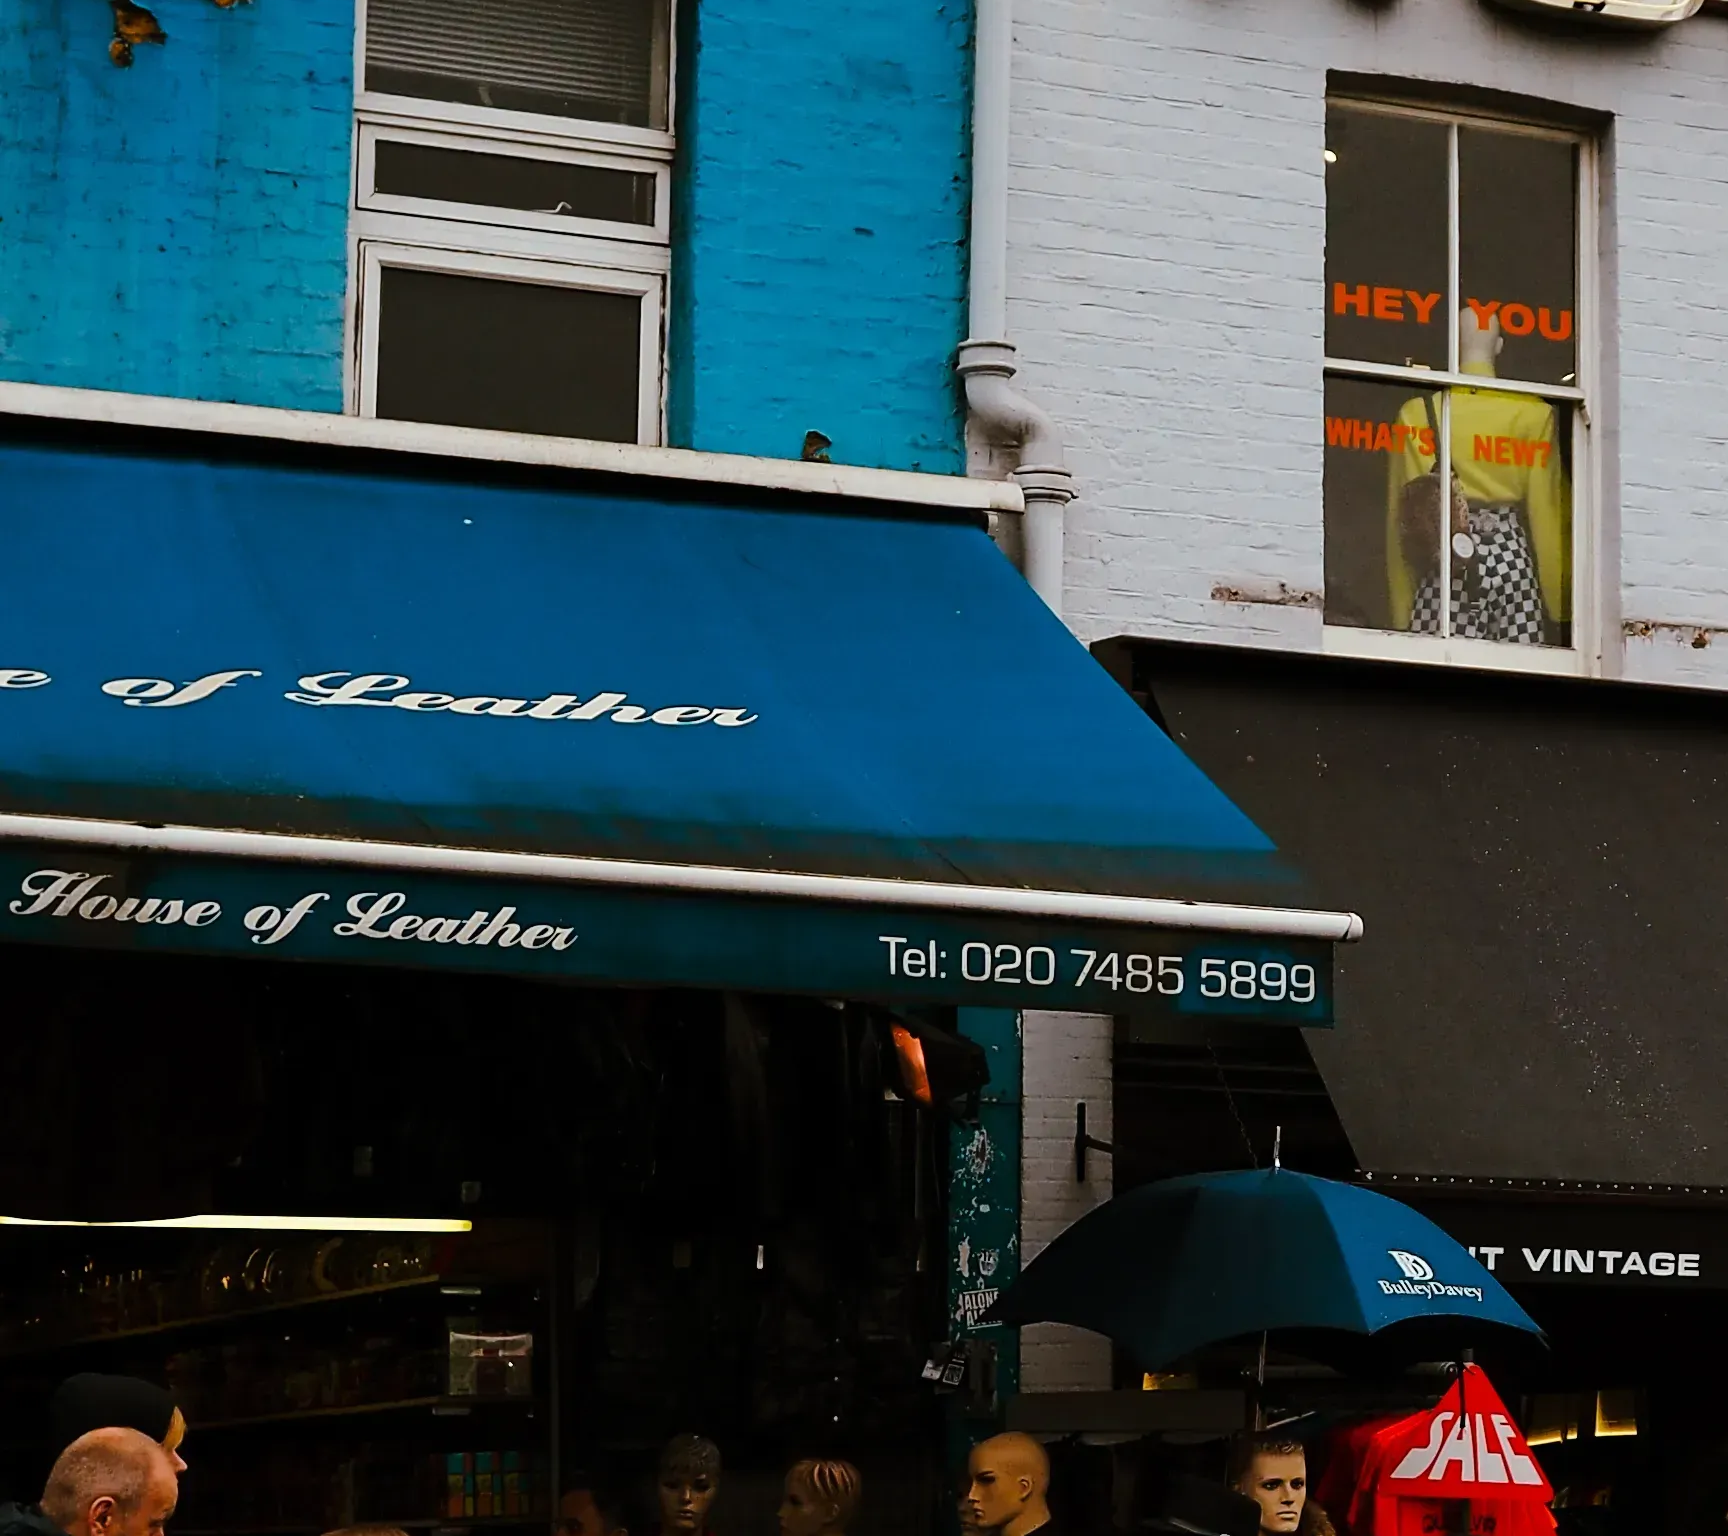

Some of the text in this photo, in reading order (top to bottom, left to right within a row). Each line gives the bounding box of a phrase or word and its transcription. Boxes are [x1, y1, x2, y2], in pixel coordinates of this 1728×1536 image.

[1333, 282, 1572, 341] HEY YOU
[1326, 417, 1552, 469] WHAT'S NEW?
[101, 670, 262, 708] of
[284, 670, 759, 728] Leather
[8, 868, 578, 952] House of Leather
[878, 935, 1317, 1003] Tel: 020 7485 5899
[1378, 1279, 1483, 1301] BulleyDavey
[1522, 1247, 1701, 1277] VINTAGE
[1390, 1411, 1544, 1486] SALE
